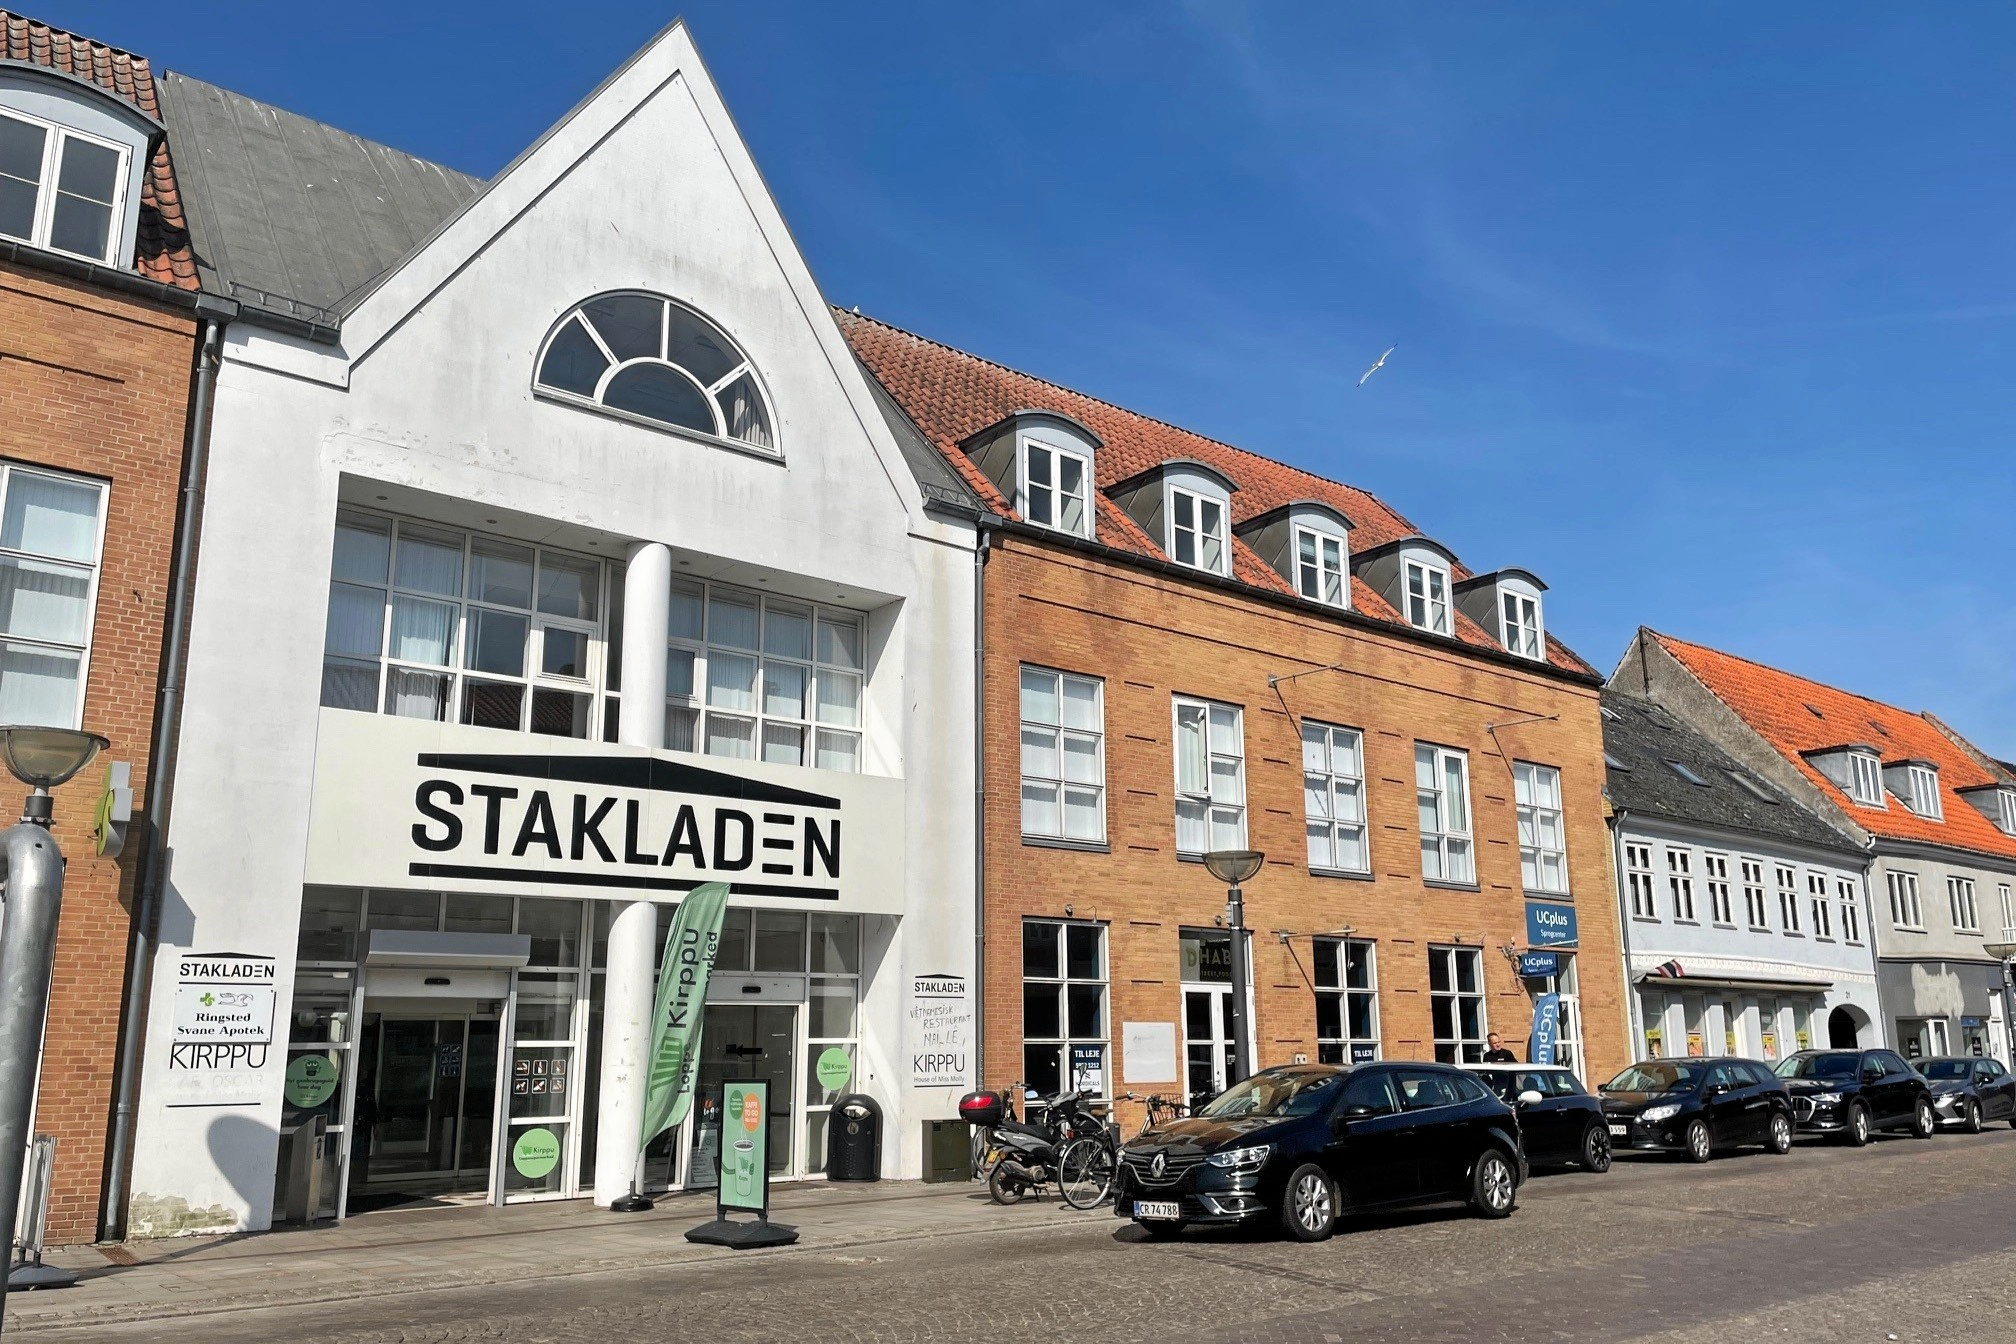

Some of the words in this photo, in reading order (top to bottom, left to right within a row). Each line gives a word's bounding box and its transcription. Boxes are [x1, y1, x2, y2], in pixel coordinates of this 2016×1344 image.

[411, 779, 840, 879] STAKLADEN
[1536, 910, 1568, 927] UCplus
[1540, 929, 1566, 938] Sprogcenter
[1185, 947, 1231, 967] DHAB
[1524, 957, 1553, 967] UCplus
[179, 963, 275, 978] STAKLADEN
[666, 928, 699, 1029] Kirppu
[914, 982, 965, 993] STAKLADEN
[195, 1013, 251, 1024] Ringsted
[177, 1025, 215, 1035] Svane
[219, 1026, 265, 1037] Apotek
[169, 1044, 267, 1069] KIRPPU
[1074, 1050, 1085, 1058] TIL
[1085, 1050, 1100, 1058] LEJE
[913, 1054, 965, 1073] KIRPPU
[950, 1075, 965, 1083] Molly
[533, 1147, 555, 1155] Kirppu
[1140, 1204, 1150, 1215] CR
[1151, 1204, 1161, 1215] 74
[1162, 1204, 1178, 1216] 788
